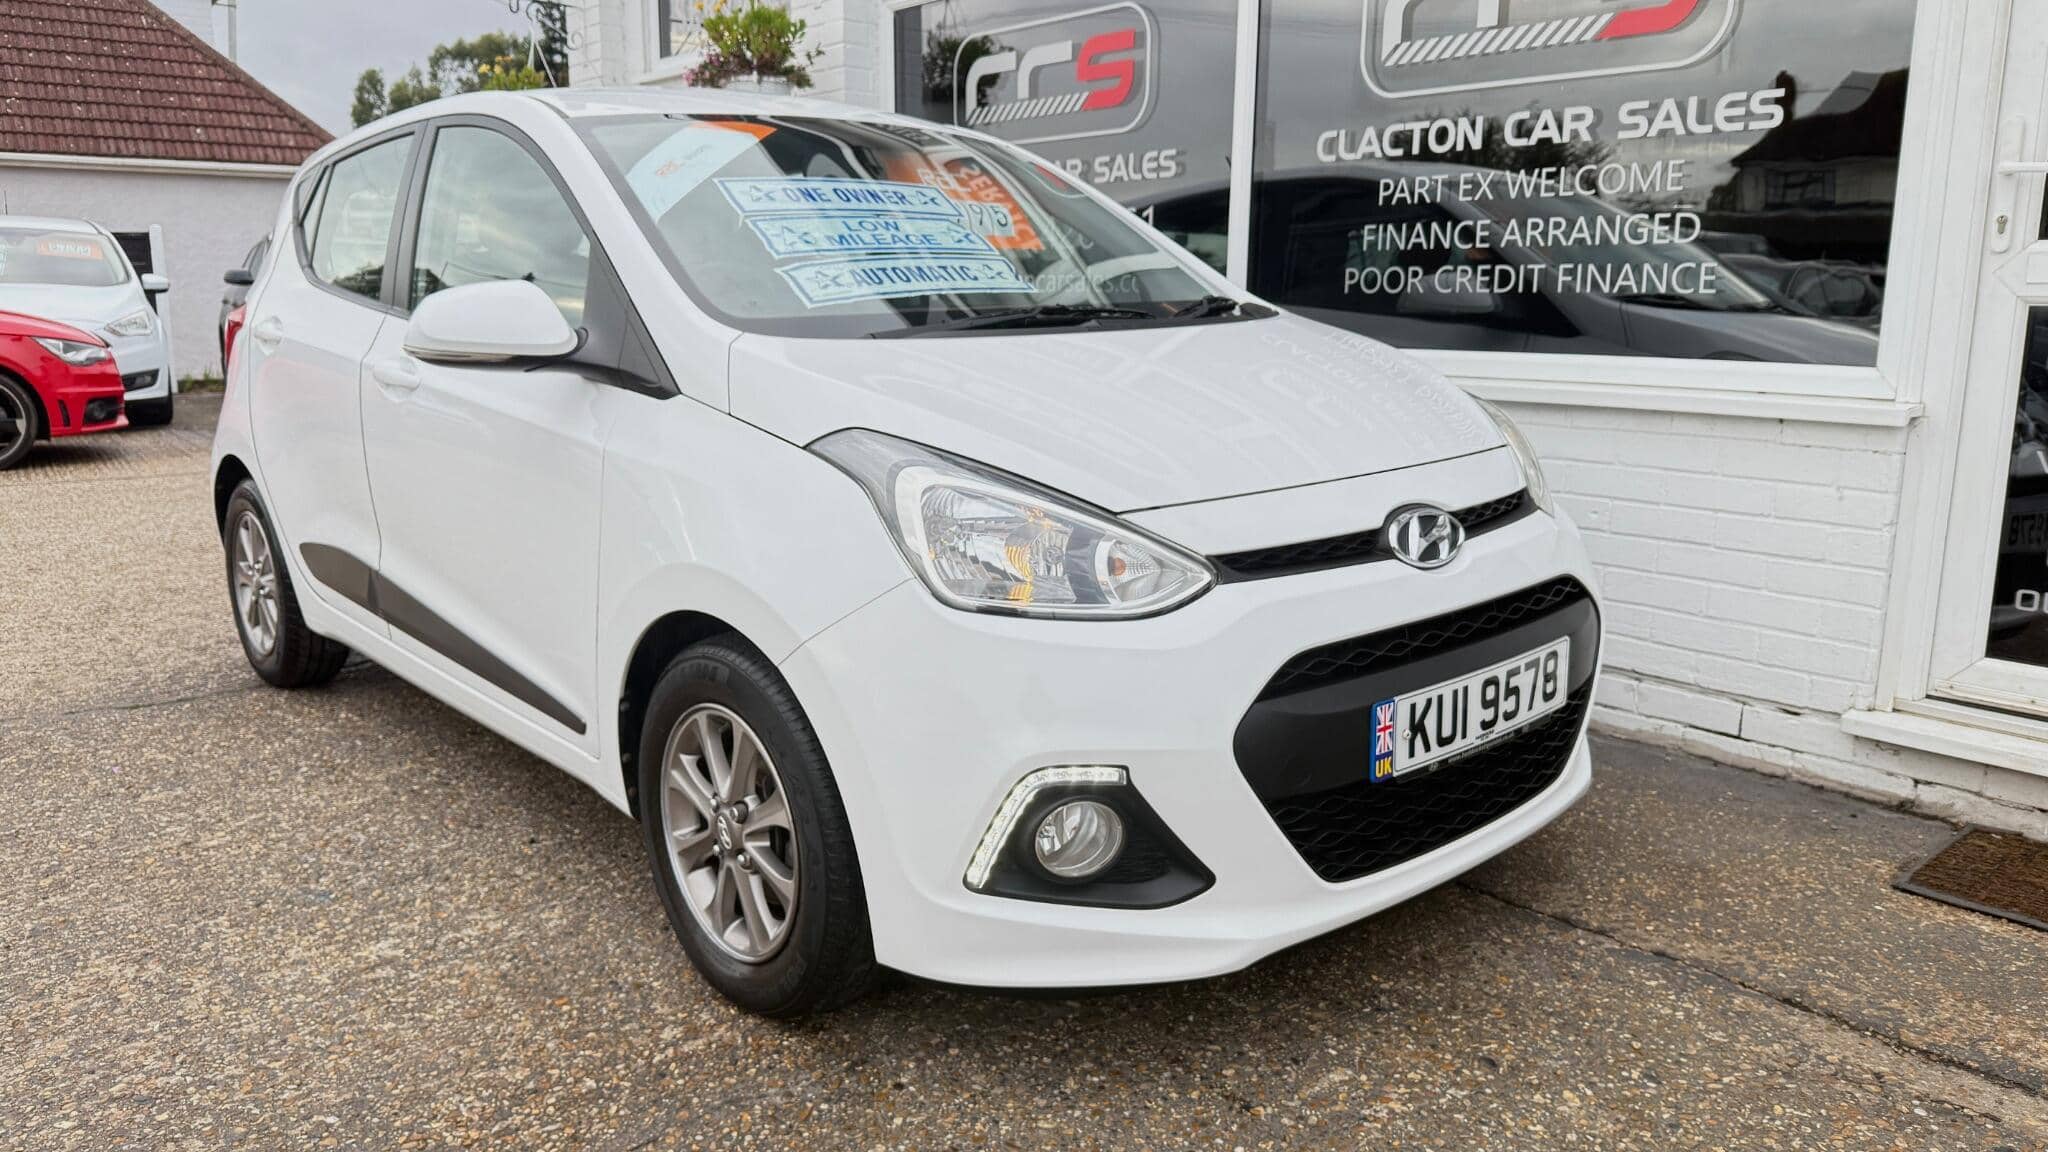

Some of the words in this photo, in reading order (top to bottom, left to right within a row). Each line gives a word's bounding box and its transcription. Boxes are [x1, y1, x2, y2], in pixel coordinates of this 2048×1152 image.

[1316, 115, 1485, 163] CLACTON
[1503, 105, 1595, 148] CAR
[1617, 87, 1787, 140] SALES
[1093, 147, 1179, 185] SALES
[1377, 173, 1449, 207] PART
[1457, 171, 1496, 202] EX
[1505, 159, 1686, 200] WELCOME
[784, 186, 832, 203] ONE
[832, 187, 911, 206] OWNER
[825, 233, 943, 248] MILEAGE
[842, 220, 901, 233] LOW
[1361, 218, 1492, 252] FINANCE
[1499, 211, 1701, 249] ARRANGED
[850, 264, 980, 288] AUTOMATIC
[1343, 266, 1425, 295] POOR
[1433, 264, 1547, 295] CREDIT
[1556, 261, 1719, 295] FINANCE
[1407, 684, 1469, 760] KUI
[1479, 649, 1559, 732] 9578
[1374, 757, 1393, 779] UK
